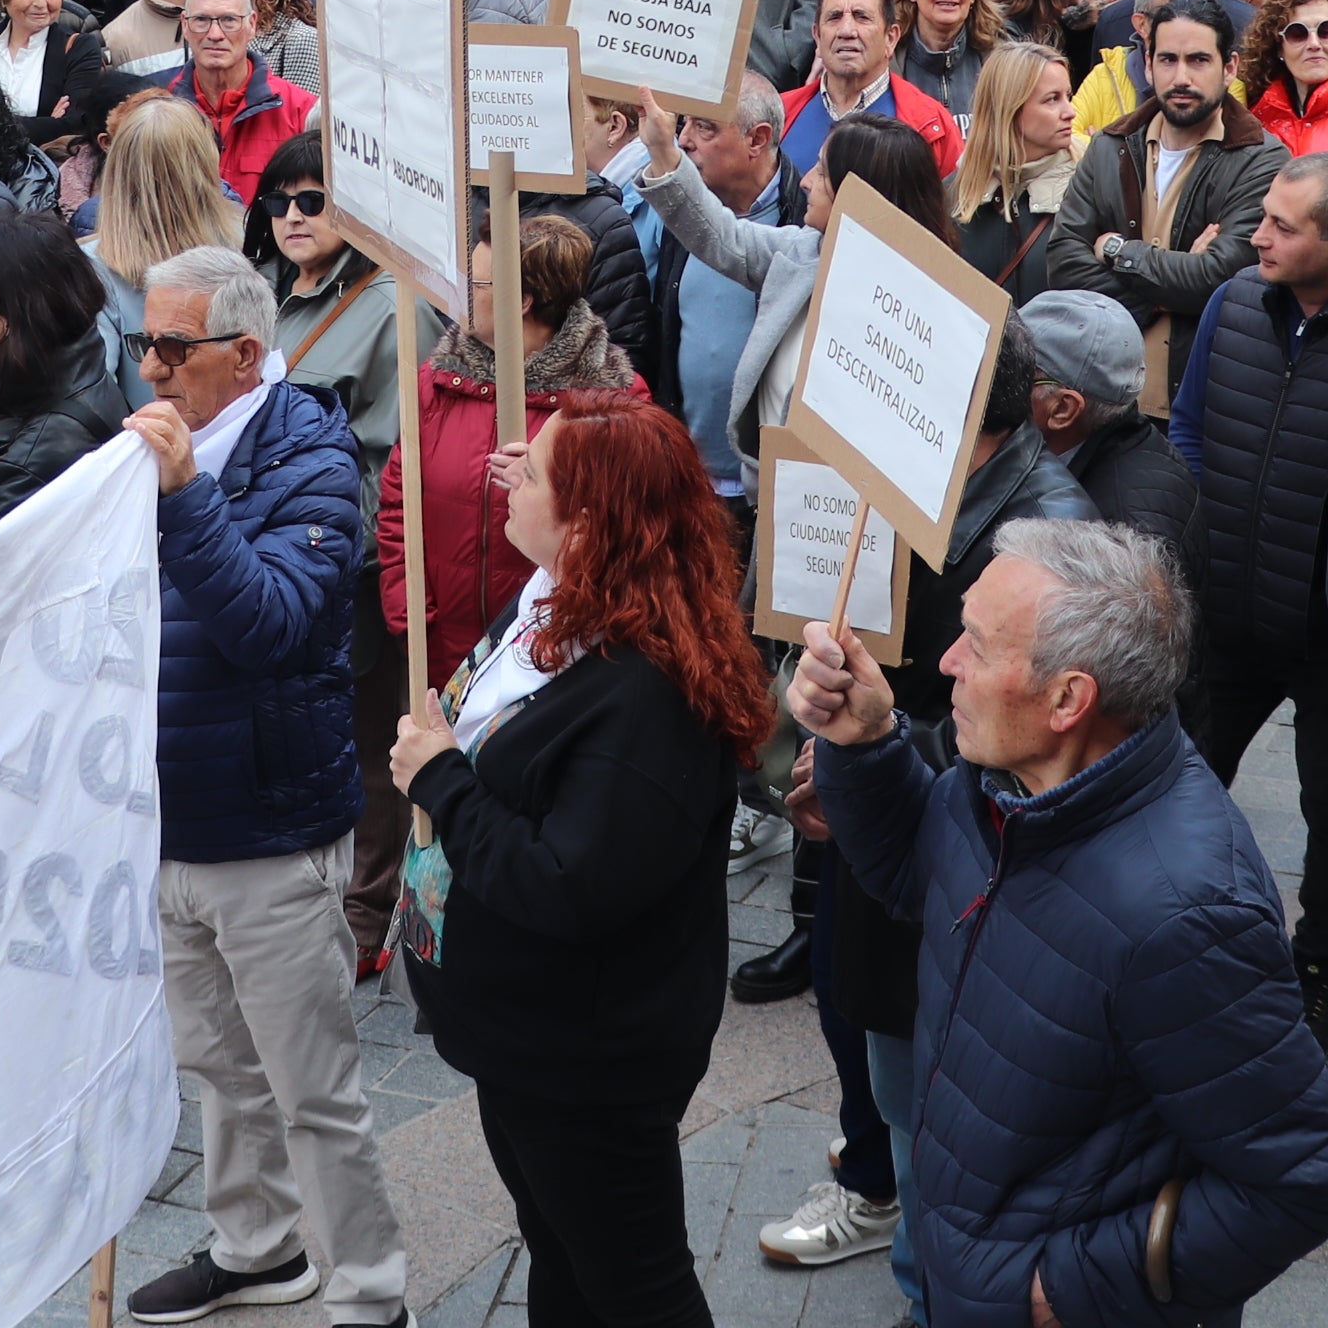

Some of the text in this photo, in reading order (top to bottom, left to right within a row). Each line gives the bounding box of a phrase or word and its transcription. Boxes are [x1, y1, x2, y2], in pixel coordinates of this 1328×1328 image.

[607, 8, 696, 40] NO SOMOS
[596, 33, 699, 69] DE SEGUNDA
[484, 69, 544, 85] MANTENER
[471, 90, 534, 106] EXCELENTES
[471, 112, 540, 128] CUIDADOS AL
[333, 114, 381, 170] NO A LA
[481, 134, 530, 150] PACIENTE
[392, 157, 444, 204] ABSORCION
[871, 283, 934, 350] POR UNA
[863, 324, 925, 386] SANIDAD
[826, 337, 945, 454] DESCENTRALIZADA
[803, 492, 857, 518] NO SOMO
[789, 520, 878, 553] CIUDADANO DE
